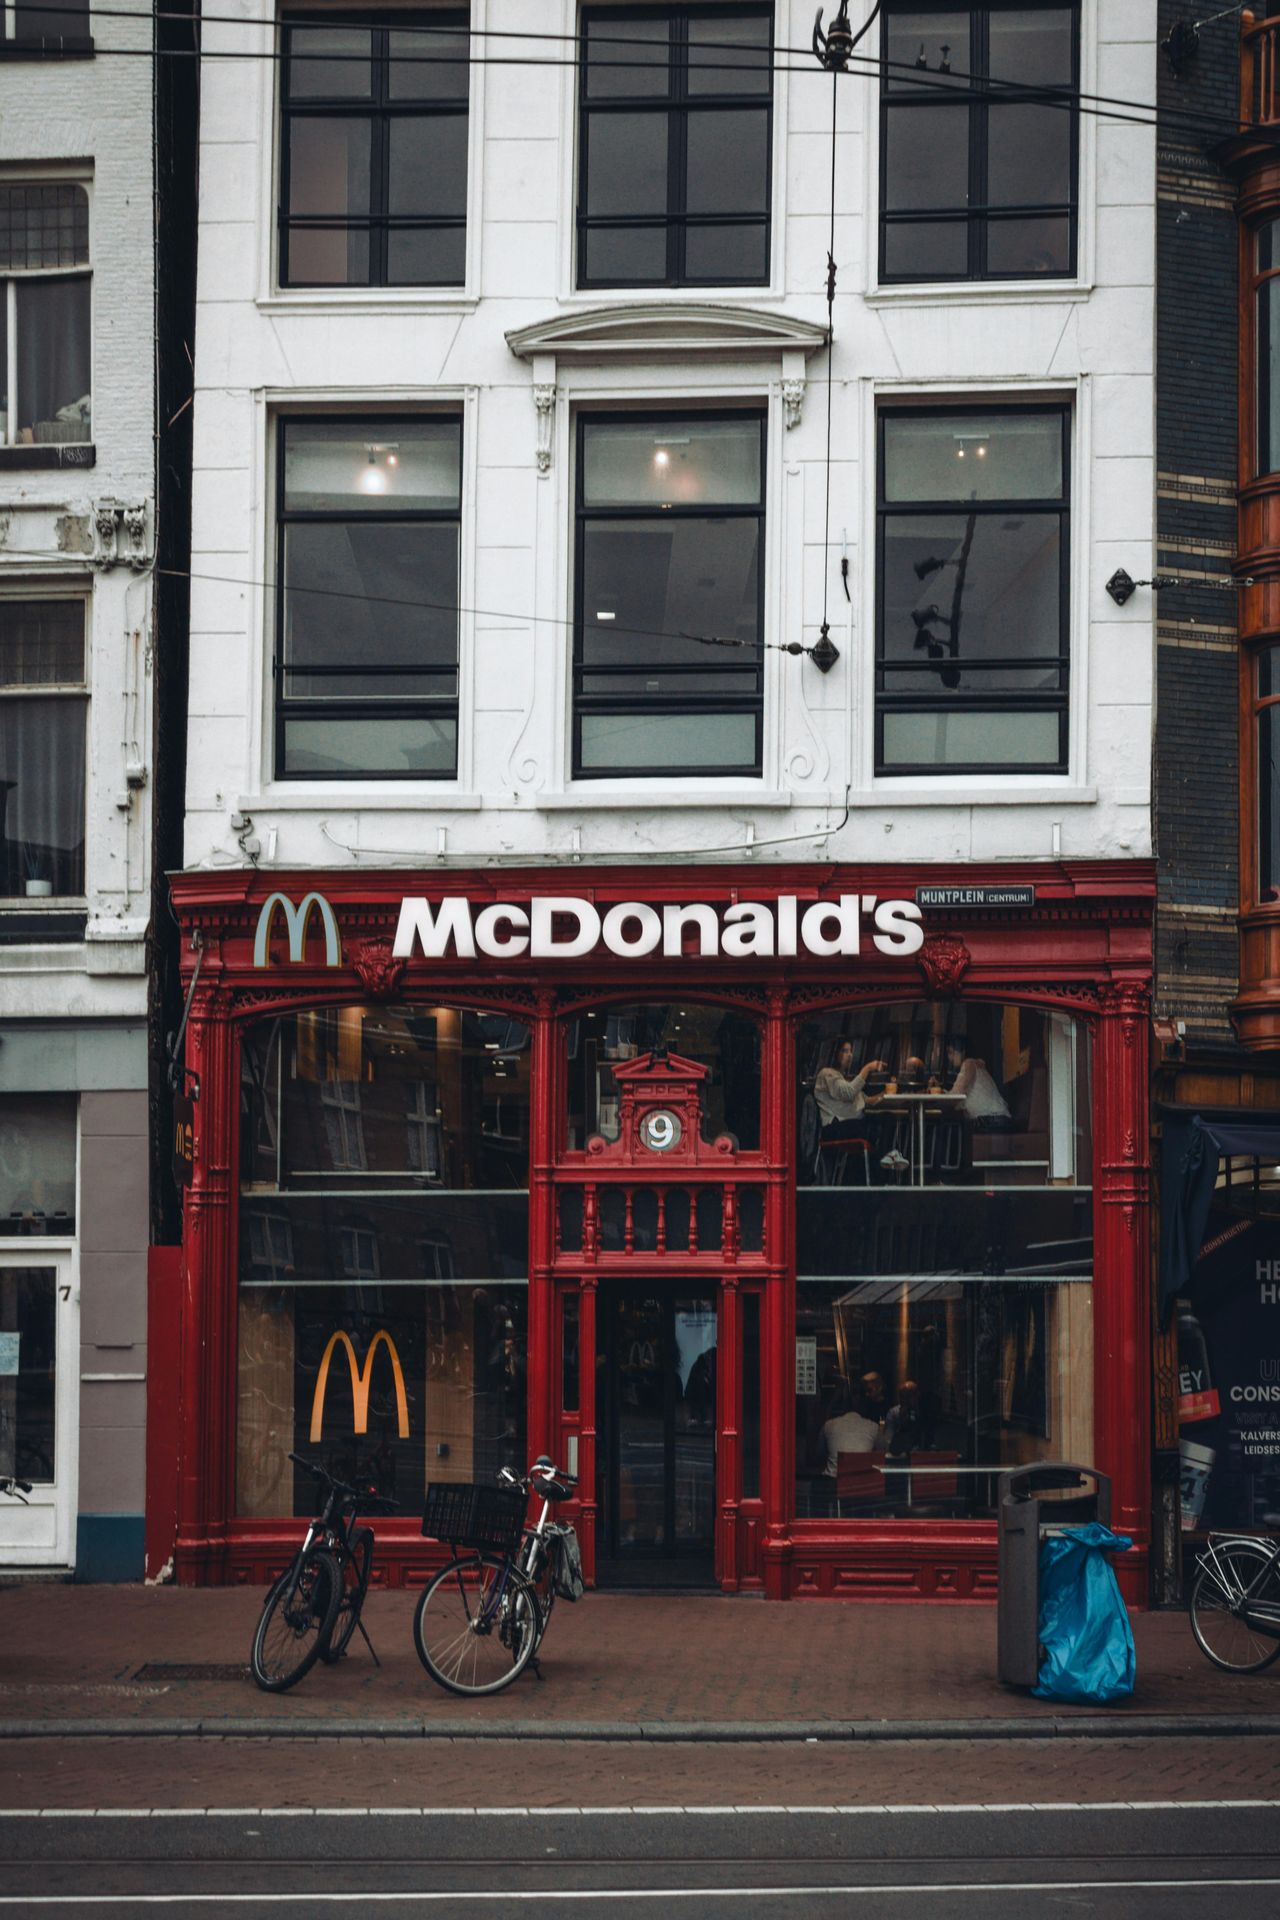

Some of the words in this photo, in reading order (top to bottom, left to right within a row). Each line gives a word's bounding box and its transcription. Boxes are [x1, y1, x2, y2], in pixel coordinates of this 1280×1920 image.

[921, 890, 984, 903] MUNTPLEIN
[392, 894, 924, 959] McDonald's
[647, 1112, 675, 1150] 9
[59, 1286, 71, 1301] 7
[1230, 1385, 1280, 1402] CONS
[1244, 1445, 1280, 1455] LEIDSES
